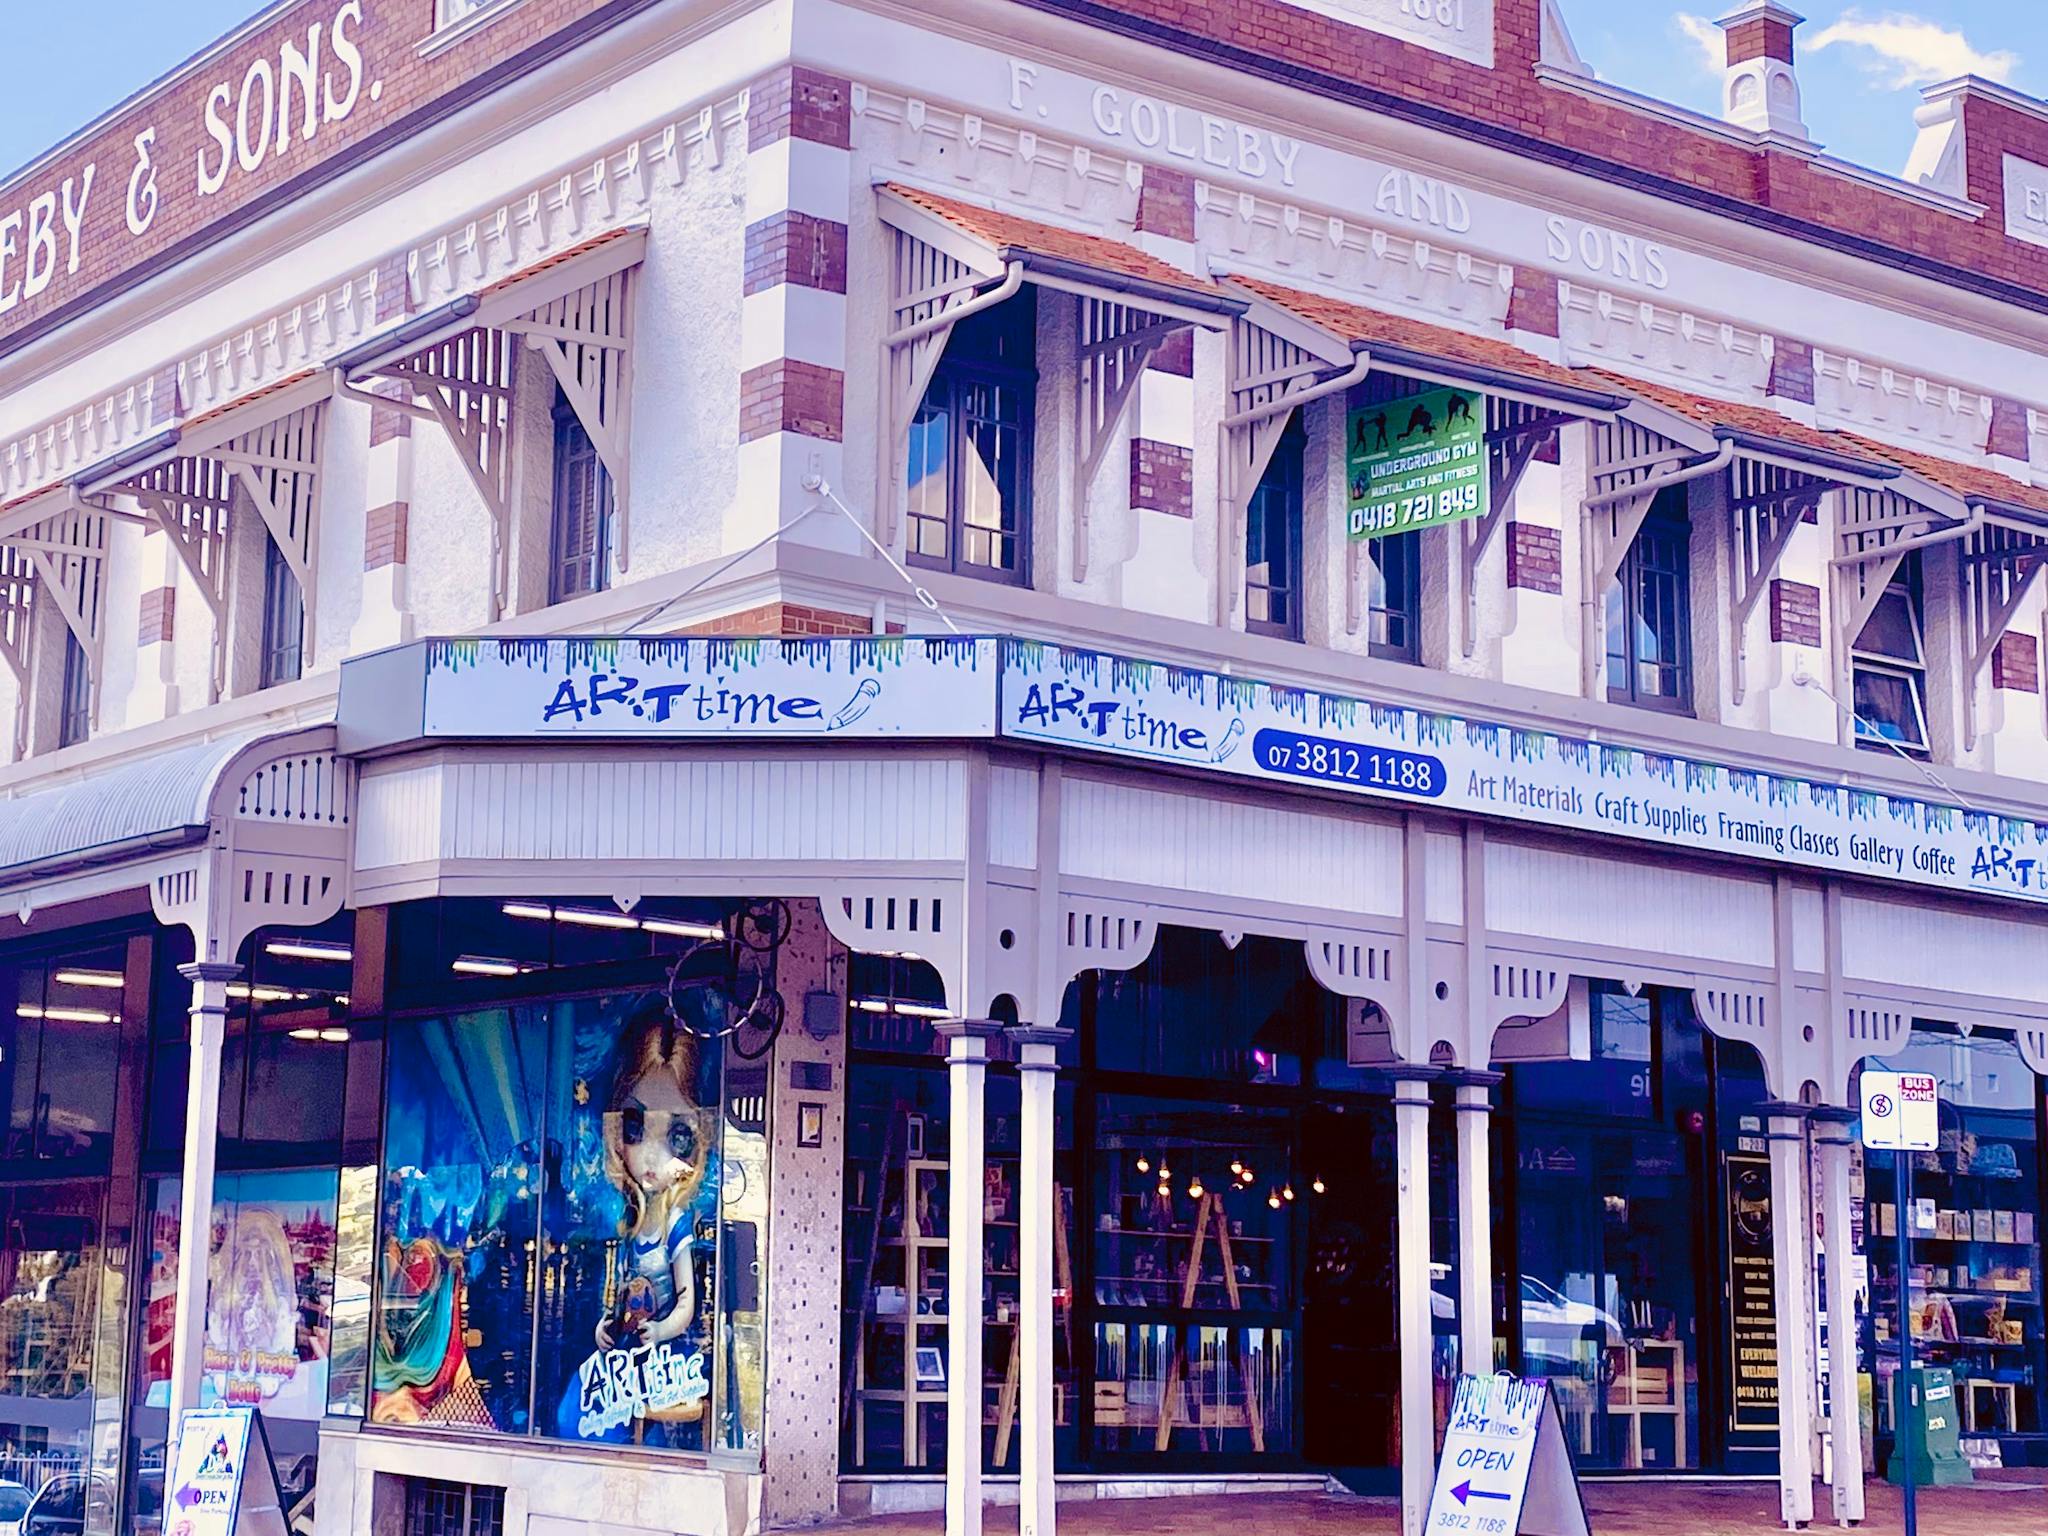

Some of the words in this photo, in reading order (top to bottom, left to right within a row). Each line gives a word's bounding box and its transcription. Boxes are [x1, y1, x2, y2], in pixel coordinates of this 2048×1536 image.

[126, 127, 158, 236] &
[1093, 86, 1301, 187] GOLEBY
[1376, 169, 1472, 234] AND
[1546, 214, 1669, 290] SONS
[1371, 447, 1450, 479] UNDERGROUND
[1452, 441, 1477, 461] GYM
[1371, 480, 1404, 498] MARTIAL
[1406, 476, 1427, 489] ARTS
[1427, 473, 1443, 486] AND
[1445, 464, 1478, 481] FITNESS
[1350, 501, 1398, 534] 0418
[1401, 494, 1434, 525] 721
[1438, 483, 1478, 517] 849
[1268, 748, 1291, 768] 07
[1296, 740, 1361, 781] 3812
[1368, 757, 1432, 791] 1188
[1468, 769, 1496, 802] Art
[1504, 775, 1583, 815] Materials
[1595, 790, 1639, 826] Craft
[1644, 798, 1707, 838] Supplies
[1718, 811, 1784, 854] Framing
[1790, 824, 1839, 858] Classes
[1849, 834, 1904, 873] Gallery
[1912, 844, 1956, 876] Coffee
[1902, 1089, 1934, 1102] ZONE
[1905, 1077, 1930, 1090] BUS
[1756, 1387, 1769, 1399] 721
[1457, 1448, 1514, 1471] OPEN
[193, 1489, 227, 1505] OPEN
[1438, 1512, 1471, 1528] 3812
[1476, 1516, 1507, 1533] 1188
